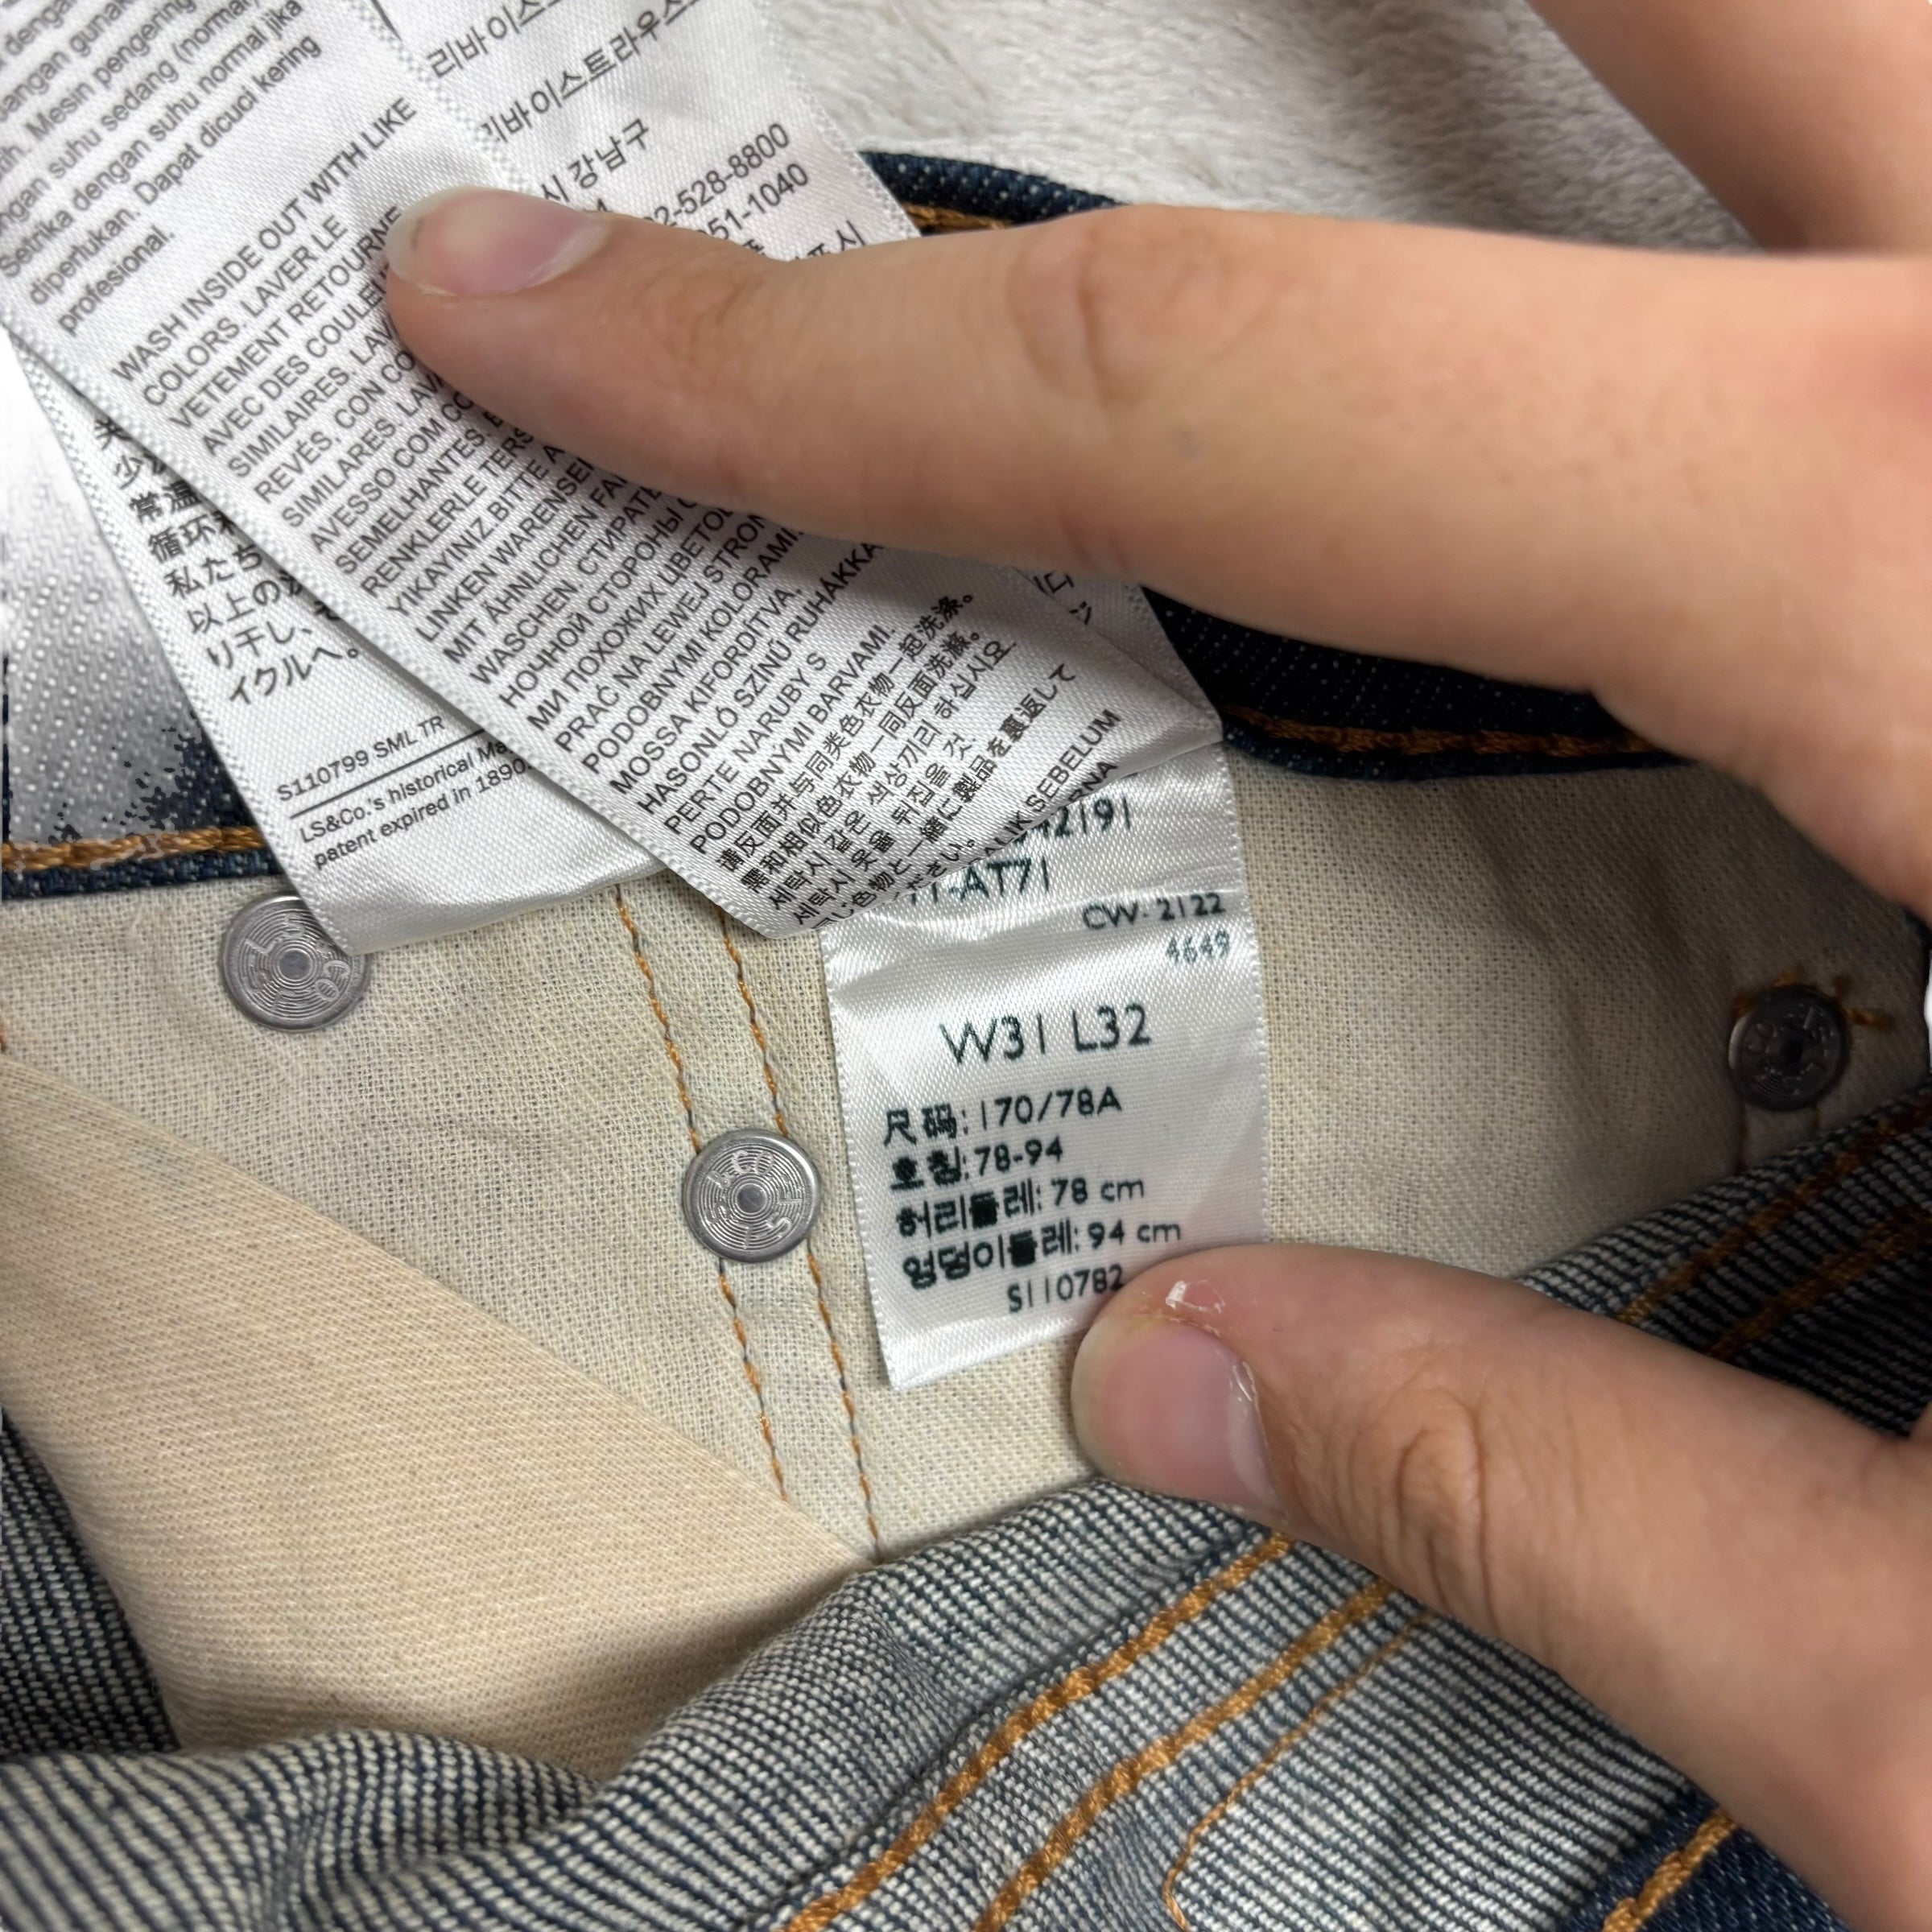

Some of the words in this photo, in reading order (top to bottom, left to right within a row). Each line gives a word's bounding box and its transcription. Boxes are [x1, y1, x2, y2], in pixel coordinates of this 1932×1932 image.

[2, 0, 79, 60] denga
[426, 0, 564, 80] 리바이스
[0, 175, 52, 233] ngan
[46, 126, 102, 179] suhu
[97, 57, 180, 134] sedang
[24, 78, 95, 142] Mesin
[69, 135, 153, 215] dengan
[146, 89, 201, 143] suhu
[196, 24, 269, 95] normal
[262, 0, 306, 39] jika
[566, 117, 654, 192] 강남구
[27, 202, 138, 308] diperlukan.
[132, 140, 204, 208] Dapat
[196, 85, 259, 149] dicuci
[250, 31, 323, 96] kering
[643, 122, 794, 234] 2-528-8800
[695, 161, 812, 248] 51-1040
[55, 221, 175, 337] profesional.
[110, 312, 189, 386] WASH
[180, 243, 264, 321] INSIDE
[255, 196, 310, 252] OUT
[303, 141, 369, 205] WITH
[360, 96, 418, 151] LIKE
[141, 312, 244, 409] COLORS.
[240, 243, 319, 319] LAVER
[310, 214, 349, 252] LE
[169, 317, 291, 432] VETEMENT
[200, 394, 266, 456] AVEC
[258, 352, 311, 402] DES
[227, 361, 357, 479] SIMILAIRES.
[349, 312, 402, 366] LAV
[332, 378, 387, 431] CON
[379, 346, 419, 385] CO
[280, 414, 404, 529] SIMILARES.
[307, 464, 399, 554] AVESSO
[390, 416, 448, 471] COM
[439, 390, 476, 424] CO
[334, 417, 493, 577] SEMELHANTES.
[360, 473, 487, 600] RENKLERLE
[480, 425, 535, 479] TERS
[415, 561, 498, 644] LINKEN
[488, 456, 597, 568] WARENSEI
[442, 617, 488, 666] MIT
[481, 502, 599, 626] ÄHNLICHEN
[469, 573, 584, 689] WASCHEN.
[497, 609, 594, 711] НОЧНОЙ
[585, 506, 685, 617] СТОРОНЫ
[526, 687, 570, 733] МИ
[562, 581, 667, 694] ПОХОЖИХ
[581, 637, 708, 776] PODOBNYMI
[699, 523, 806, 642] KOLORAMI.
[552, 682, 621, 754] PRAĆ
[612, 651, 650, 689] NA
[642, 580, 711, 656] LEWEJ
[634, 703, 741, 817] HASONLÓ
[782, 535, 883, 643] RUHÁKKA
[803, 621, 898, 724] BARVAMI.
[275, 749, 372, 803] S110799
[372, 729, 419, 759] SML
[418, 714, 446, 737] TR
[386, 753, 476, 804] historical
[609, 712, 687, 797] MOSSA
[663, 759, 740, 837] PERTE
[730, 667, 814, 764] NARUBY
[805, 650, 828, 672] S
[968, 811, 1033, 866] ALIK
[1023, 708, 1121, 814] SEBELUM
[312, 828, 378, 871] patent
[378, 794, 452, 839] expired
[451, 785, 472, 804] in
[767, 848, 832, 913] 세탁시
[824, 807, 872, 856] 같은
[792, 866, 856, 931] 세탁시
[848, 826, 897, 874] 옷을
[889, 760, 953, 828] 뒤집을
[942, 729, 978, 762] 것.
[1156, 892, 1226, 922] 2122
[939, 1012, 1046, 1065] W31
[1071, 1003, 1152, 1051] L32
[1051, 1176, 1088, 1207] 78
[1100, 1179, 1145, 1201] cm
[1087, 1220, 1125, 1249] 94
[1137, 1222, 1181, 1244] cm
[1007, 1264, 1124, 1313] S110782
